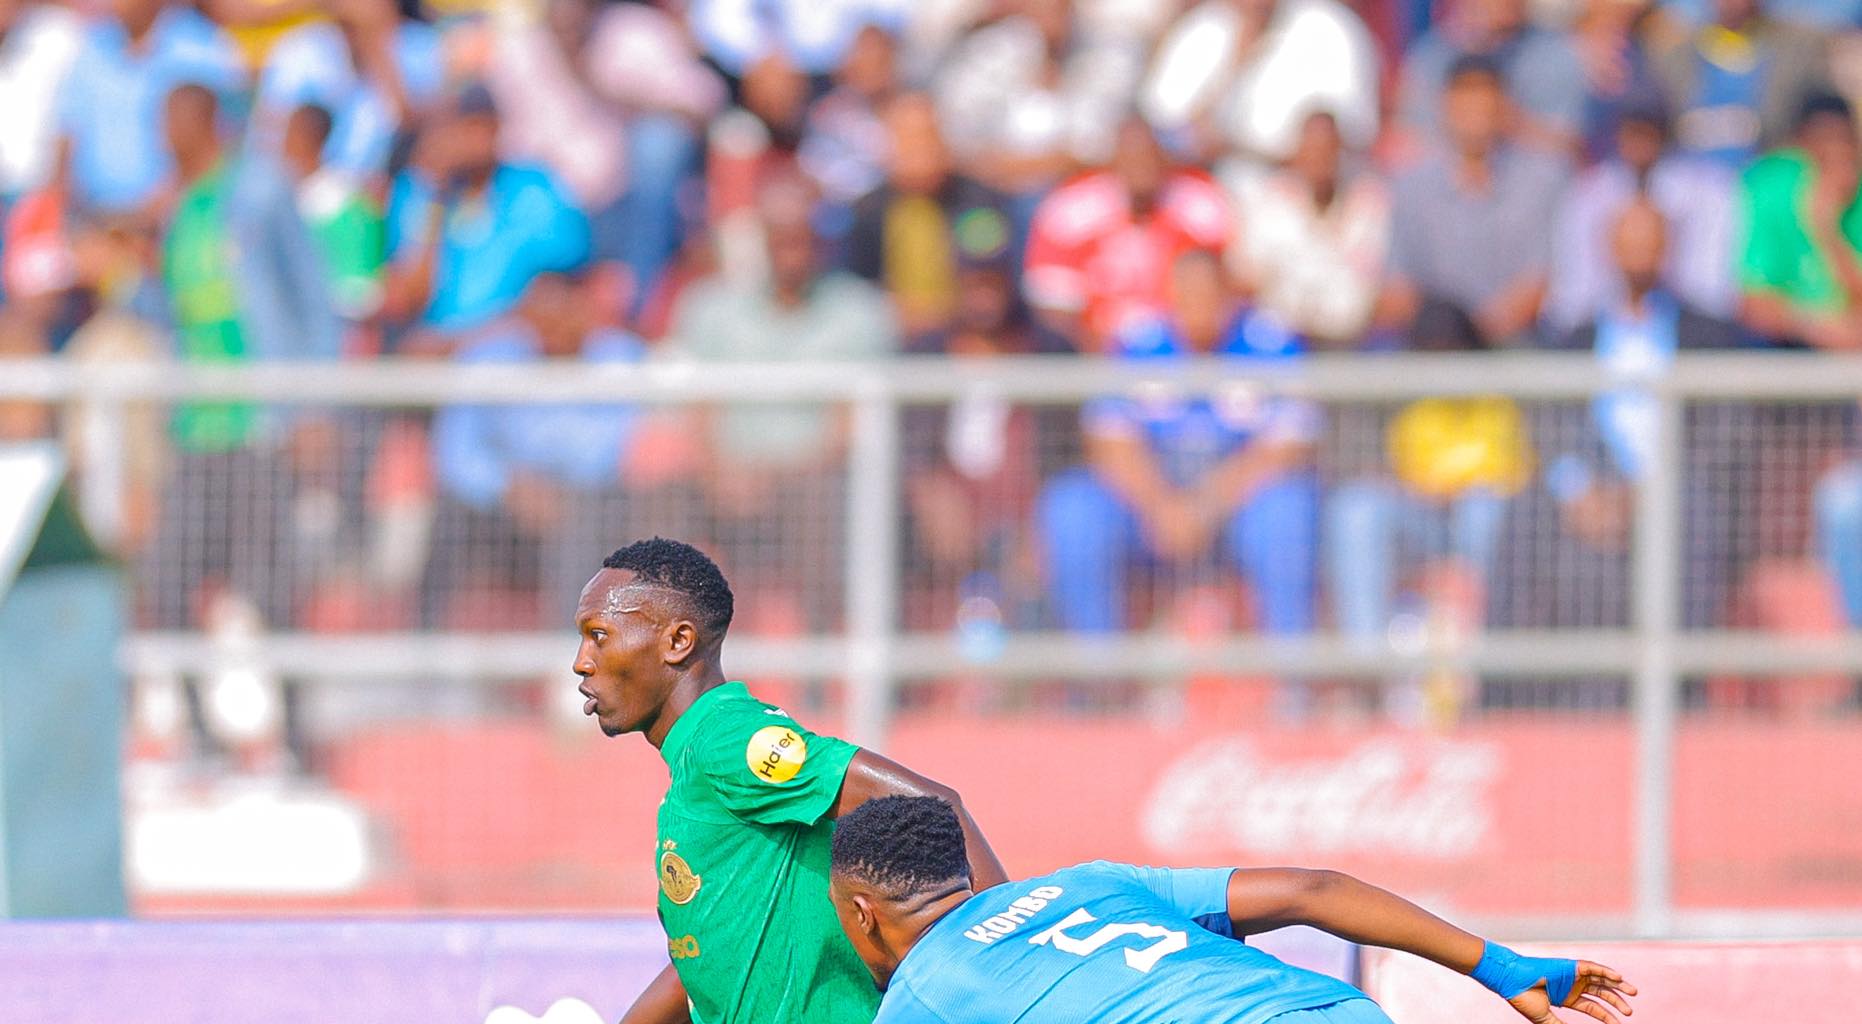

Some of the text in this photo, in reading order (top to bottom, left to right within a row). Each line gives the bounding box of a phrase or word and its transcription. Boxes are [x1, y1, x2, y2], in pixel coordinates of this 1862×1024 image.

[759, 731, 796, 779] Haier
[963, 886, 1063, 944] KOMBO
[1028, 907, 1188, 973] 5
